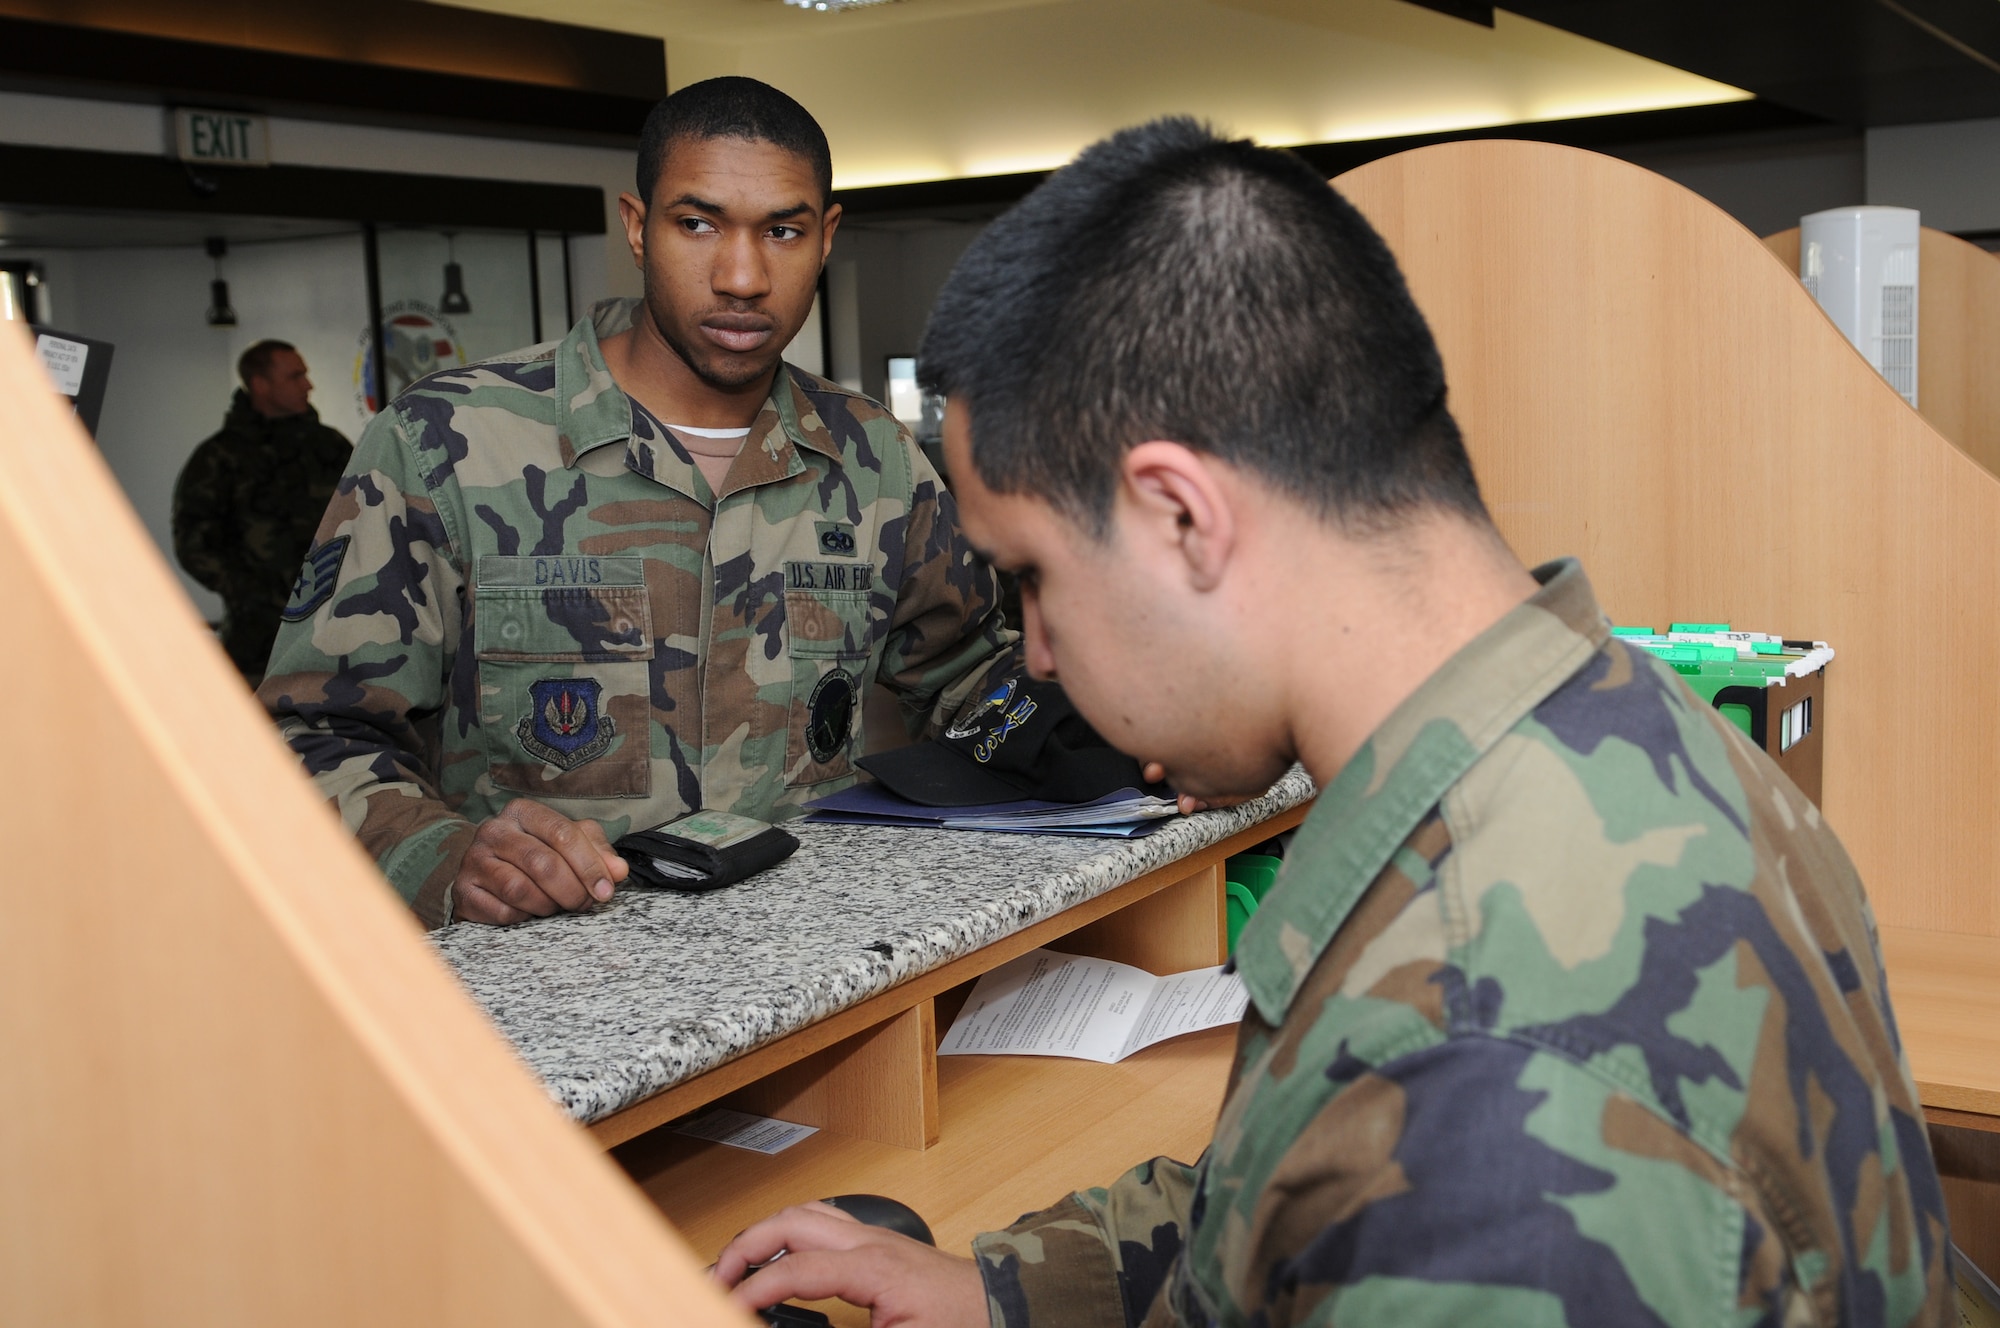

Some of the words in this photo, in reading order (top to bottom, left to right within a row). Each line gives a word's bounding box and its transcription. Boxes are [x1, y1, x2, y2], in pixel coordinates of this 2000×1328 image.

[190, 113, 251, 160] EXIT
[535, 558, 601, 584] DAVIS
[792, 564, 817, 588] U.S.
[824, 565, 846, 590] AIR
[547, 749, 575, 767] FORCS
